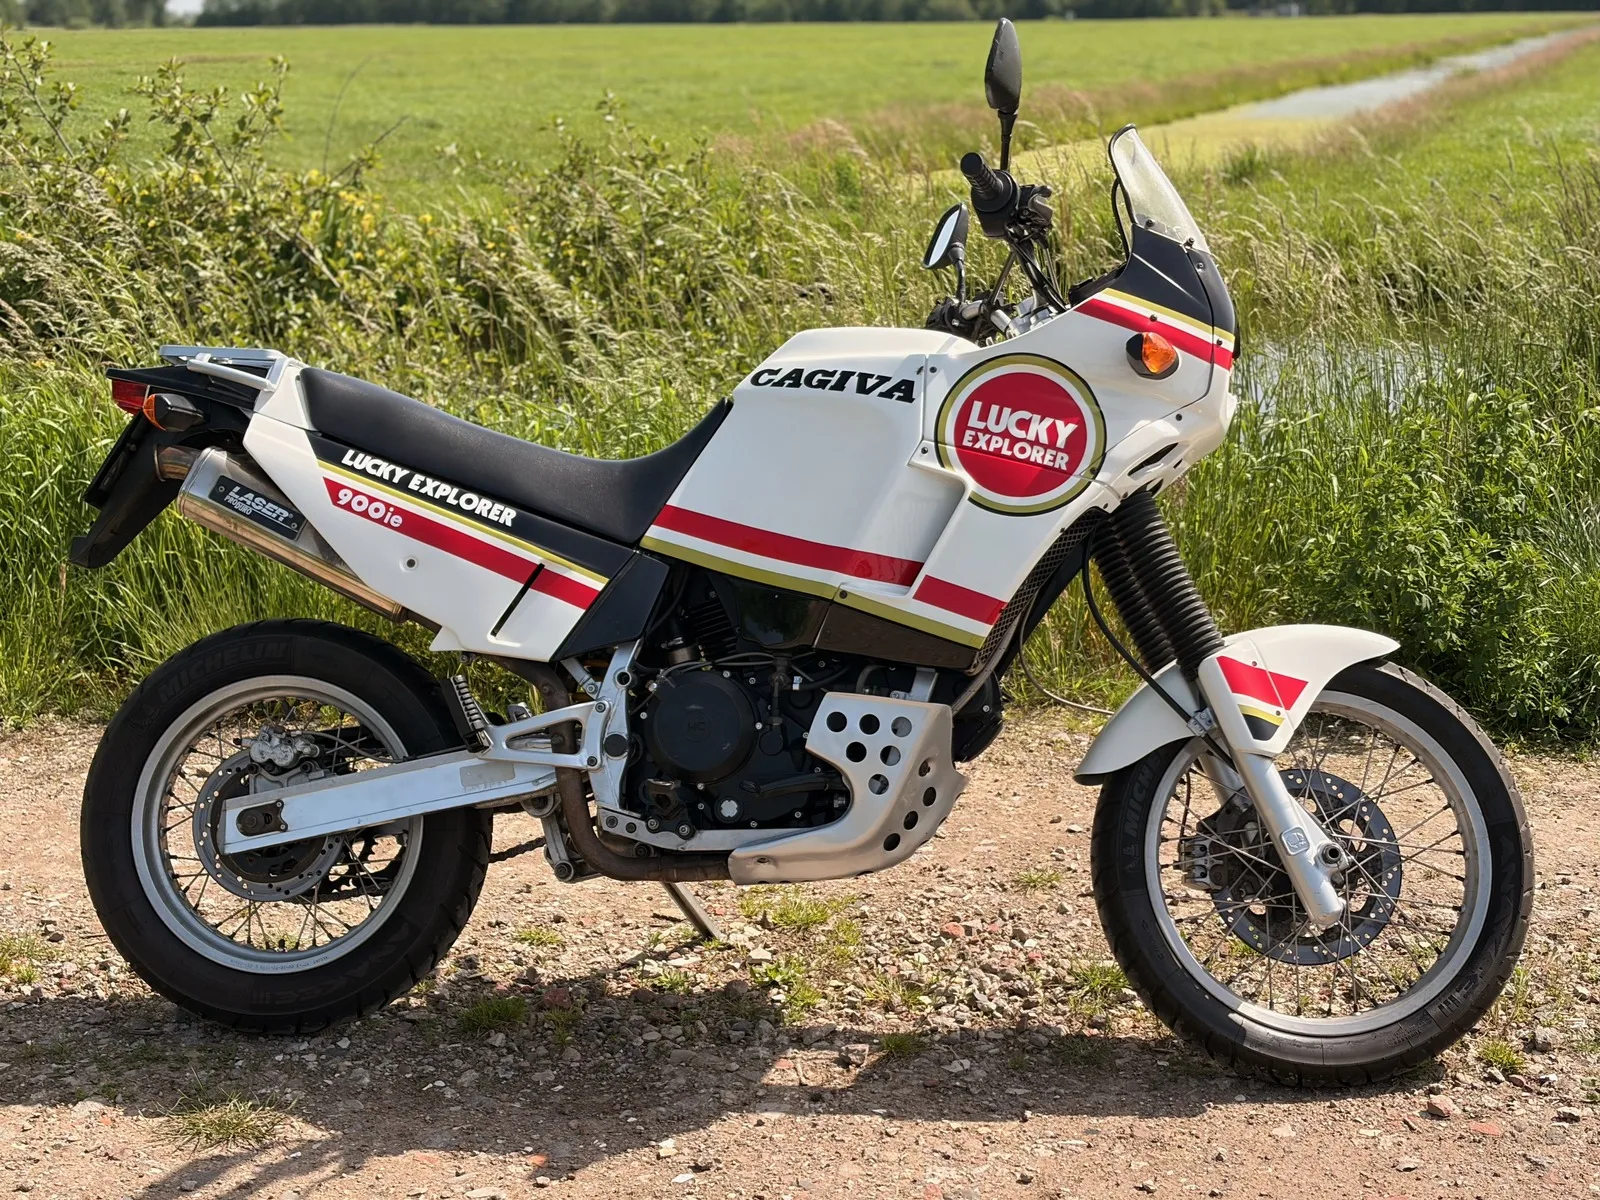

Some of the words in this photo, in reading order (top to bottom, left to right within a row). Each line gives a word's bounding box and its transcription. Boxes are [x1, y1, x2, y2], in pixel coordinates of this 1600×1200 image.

[750, 368, 916, 404] CAGIVA
[967, 400, 1079, 449] LUCKY
[962, 429, 1070, 471] EXPLORER
[336, 488, 403, 528] 900ie
[341, 449, 410, 484] LUCKY
[408, 473, 517, 527] EXPLORER
[157, 642, 288, 704] MICHELIN
[1123, 749, 1163, 838] MICHE
